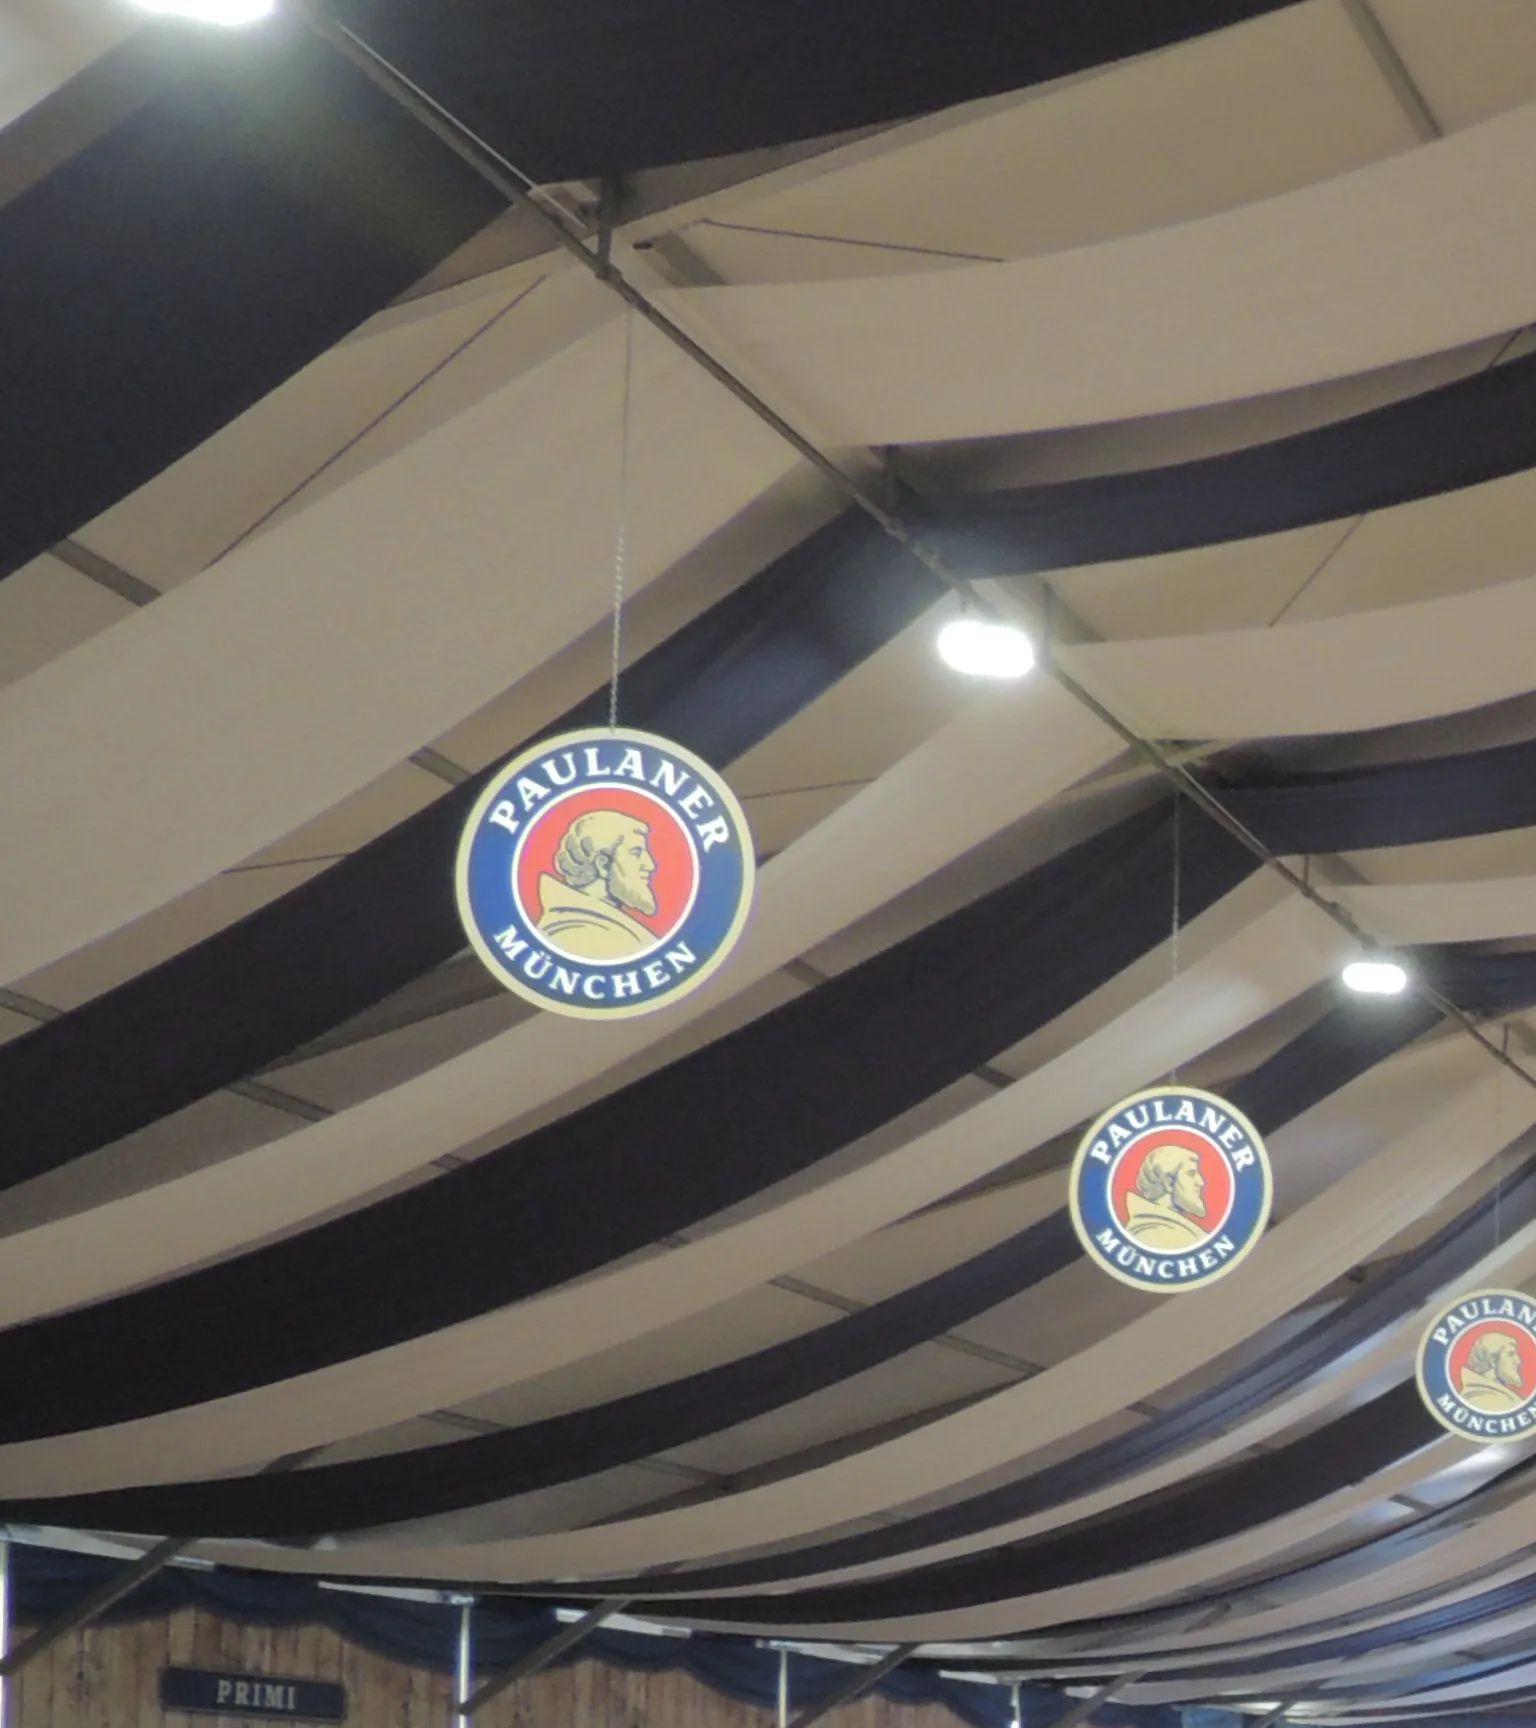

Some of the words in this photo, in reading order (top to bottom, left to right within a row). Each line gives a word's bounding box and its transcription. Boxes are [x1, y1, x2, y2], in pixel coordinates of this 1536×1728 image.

[488, 747, 731, 853] PAULANER
[492, 924, 698, 999] MÜNCHEN
[1090, 1099, 1257, 1172] PAULANER
[1096, 1228, 1236, 1279] MÜNCHEN
[216, 1678, 296, 1709] PRIMI
